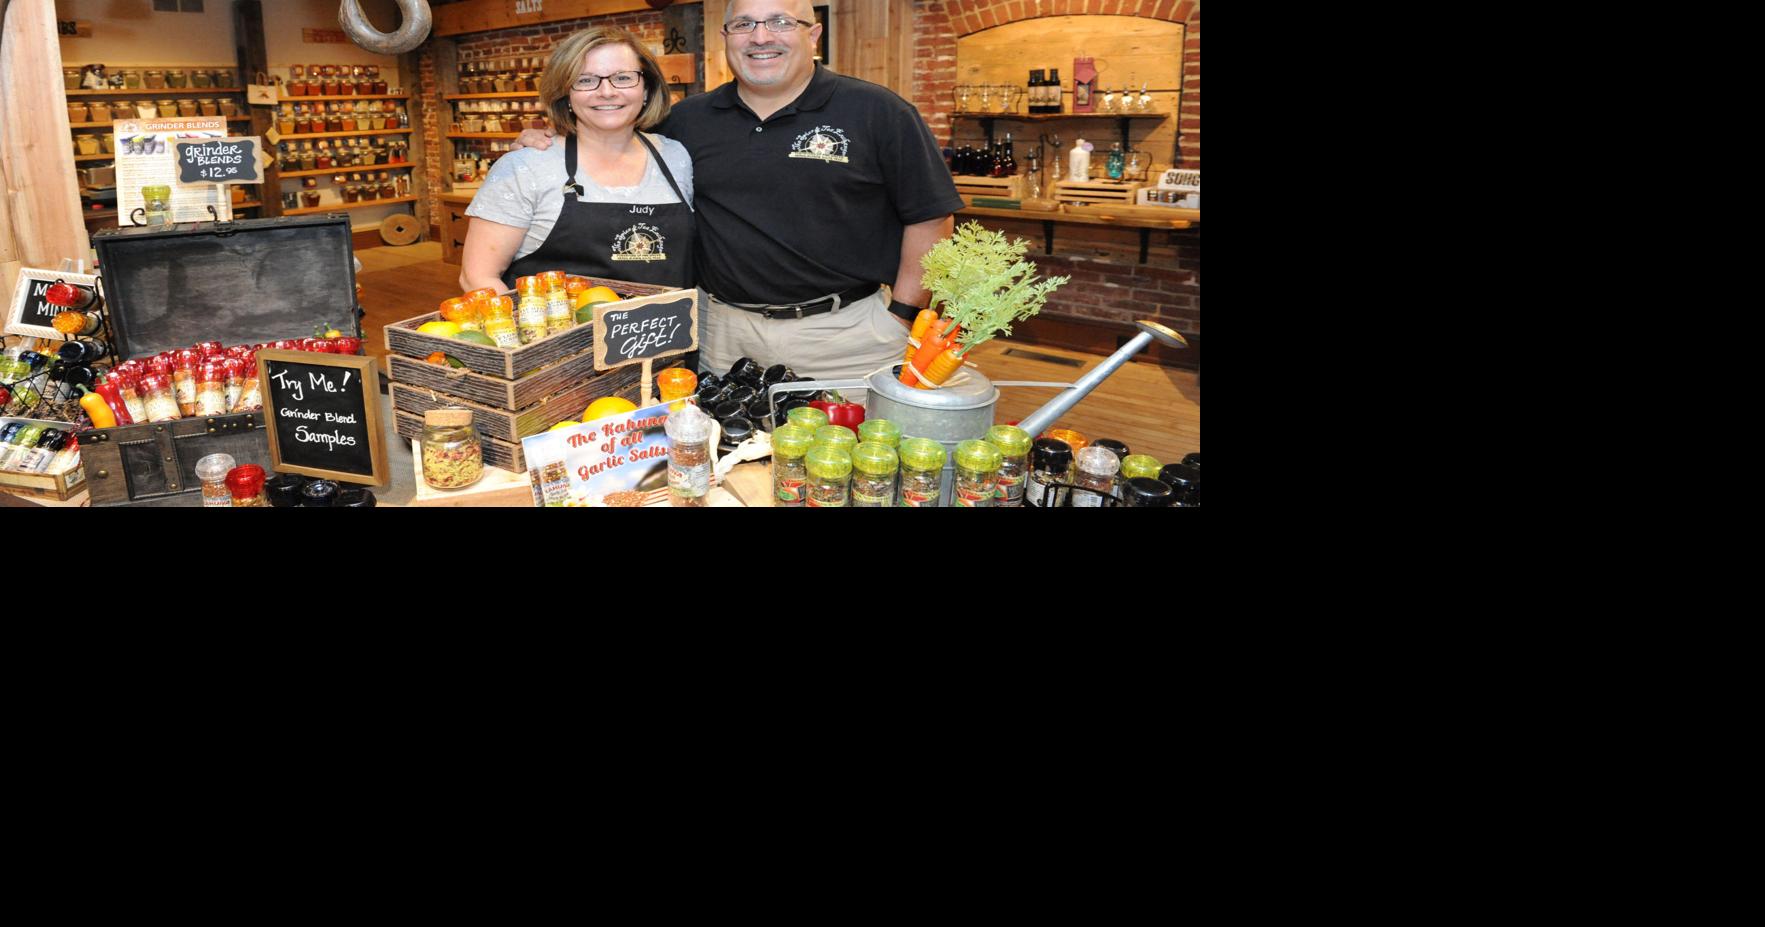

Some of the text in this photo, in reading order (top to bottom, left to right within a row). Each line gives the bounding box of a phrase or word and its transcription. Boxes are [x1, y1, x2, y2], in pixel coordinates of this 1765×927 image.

[145, 121, 220, 130] GRINDER BLENDS
[197, 155, 242, 166] BLENDS
[629, 205, 655, 216] Judy
[610, 312, 628, 321] THE
[610, 315, 677, 339] PERFECT
[271, 369, 304, 400] Try
[280, 407, 357, 424] Grinder Blend
[295, 425, 356, 452] Samples
[567, 430, 597, 449] The
[601, 430, 643, 455] of all
[577, 457, 625, 482] Garlic
